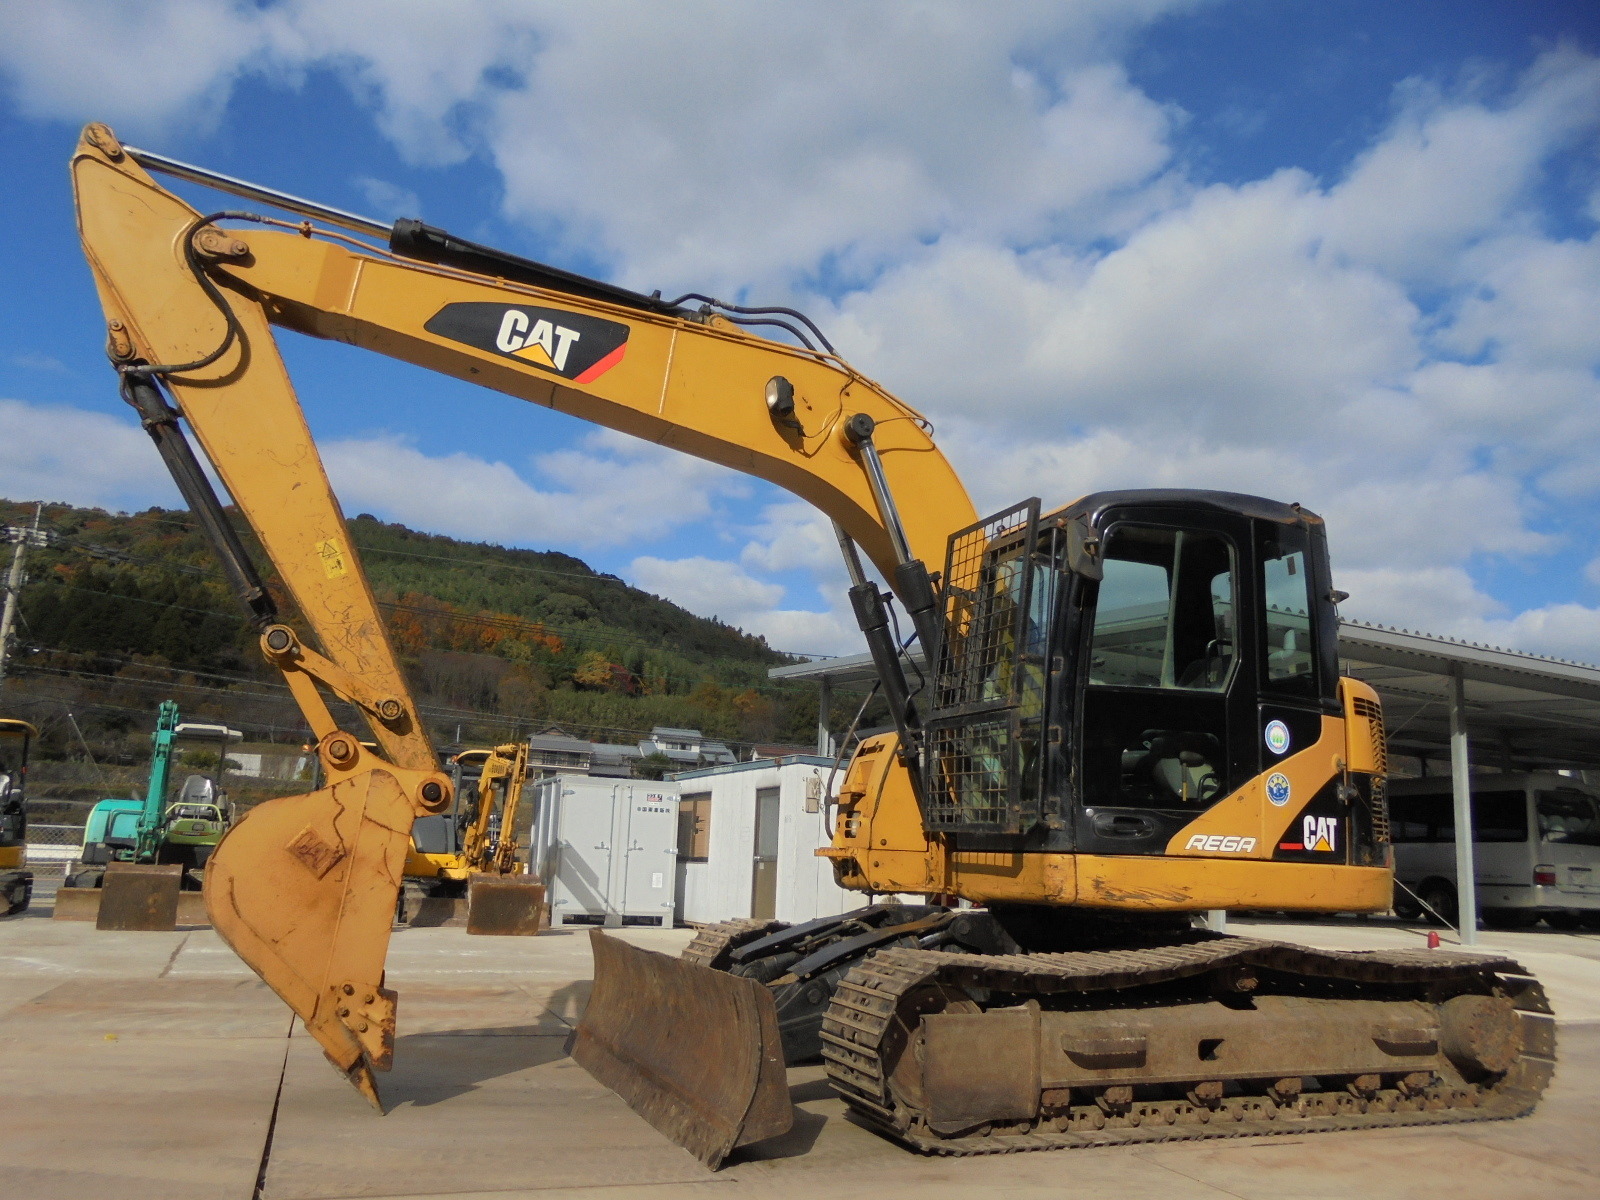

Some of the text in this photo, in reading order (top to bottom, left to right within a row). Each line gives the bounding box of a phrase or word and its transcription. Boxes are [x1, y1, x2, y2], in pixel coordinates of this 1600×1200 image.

[496, 309, 581, 372] CAT
[1184, 834, 1257, 853] REGA
[1303, 814, 1338, 852] CAT
